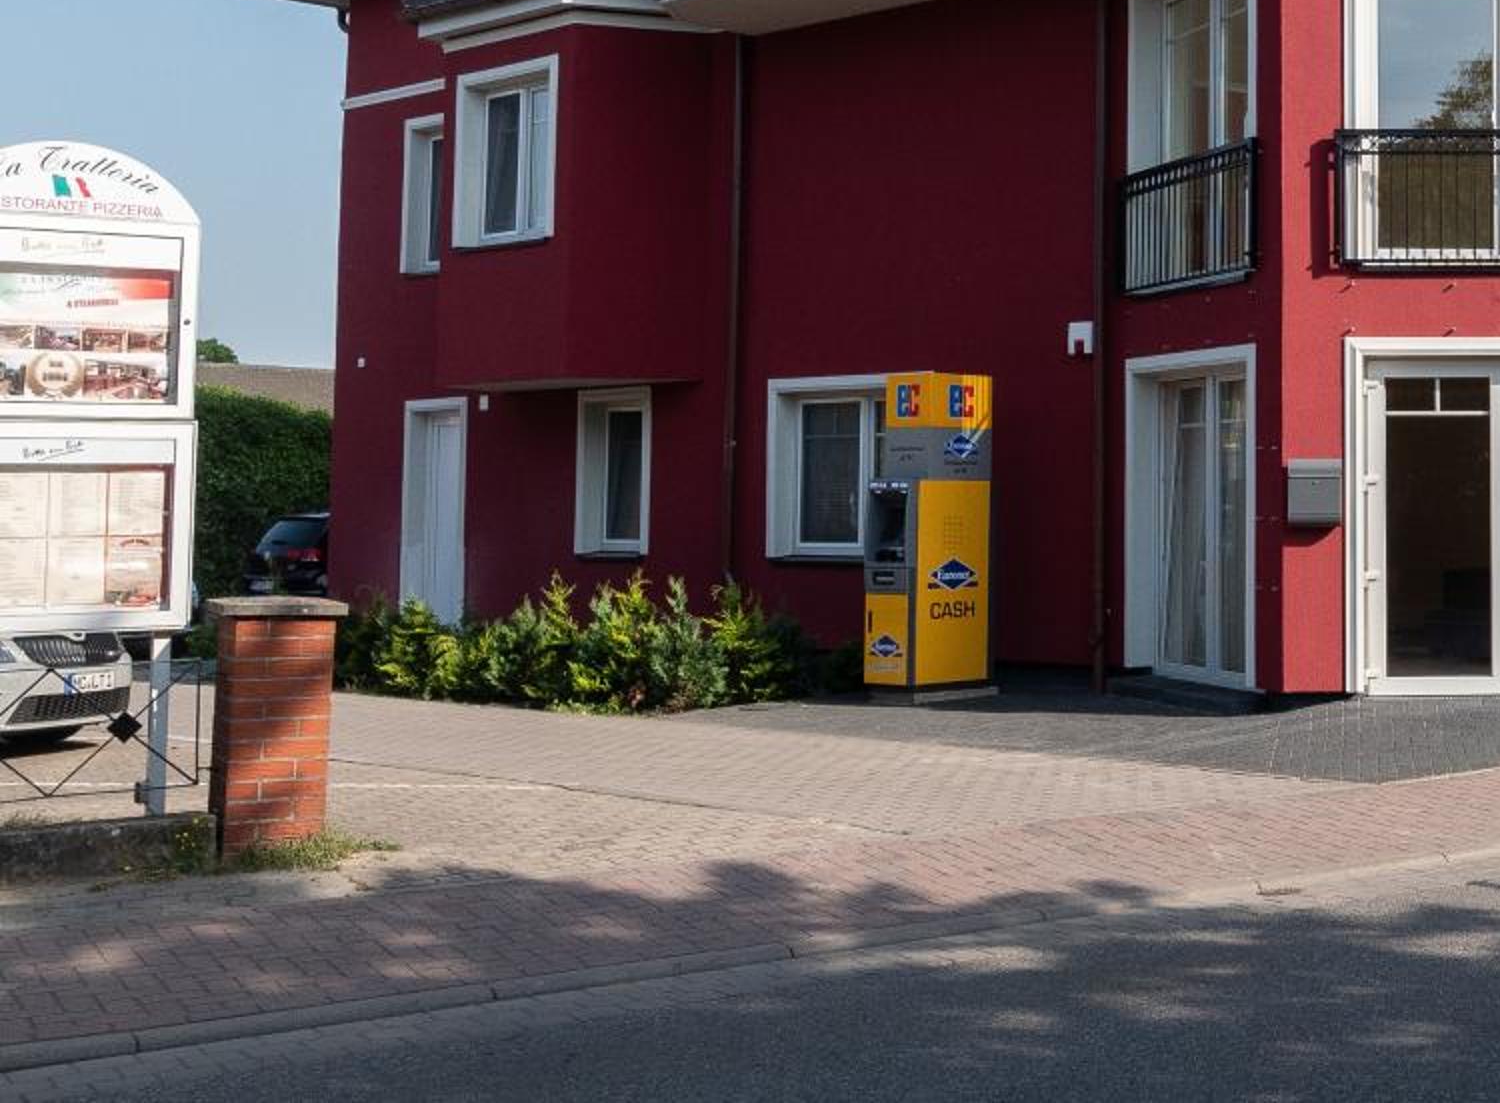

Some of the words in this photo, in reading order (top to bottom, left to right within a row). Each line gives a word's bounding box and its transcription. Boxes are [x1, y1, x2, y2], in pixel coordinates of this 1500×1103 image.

[39, 146, 159, 195] Trattoria
[93, 202, 162, 218] PIZZERIA
[930, 600, 975, 620] CASH
